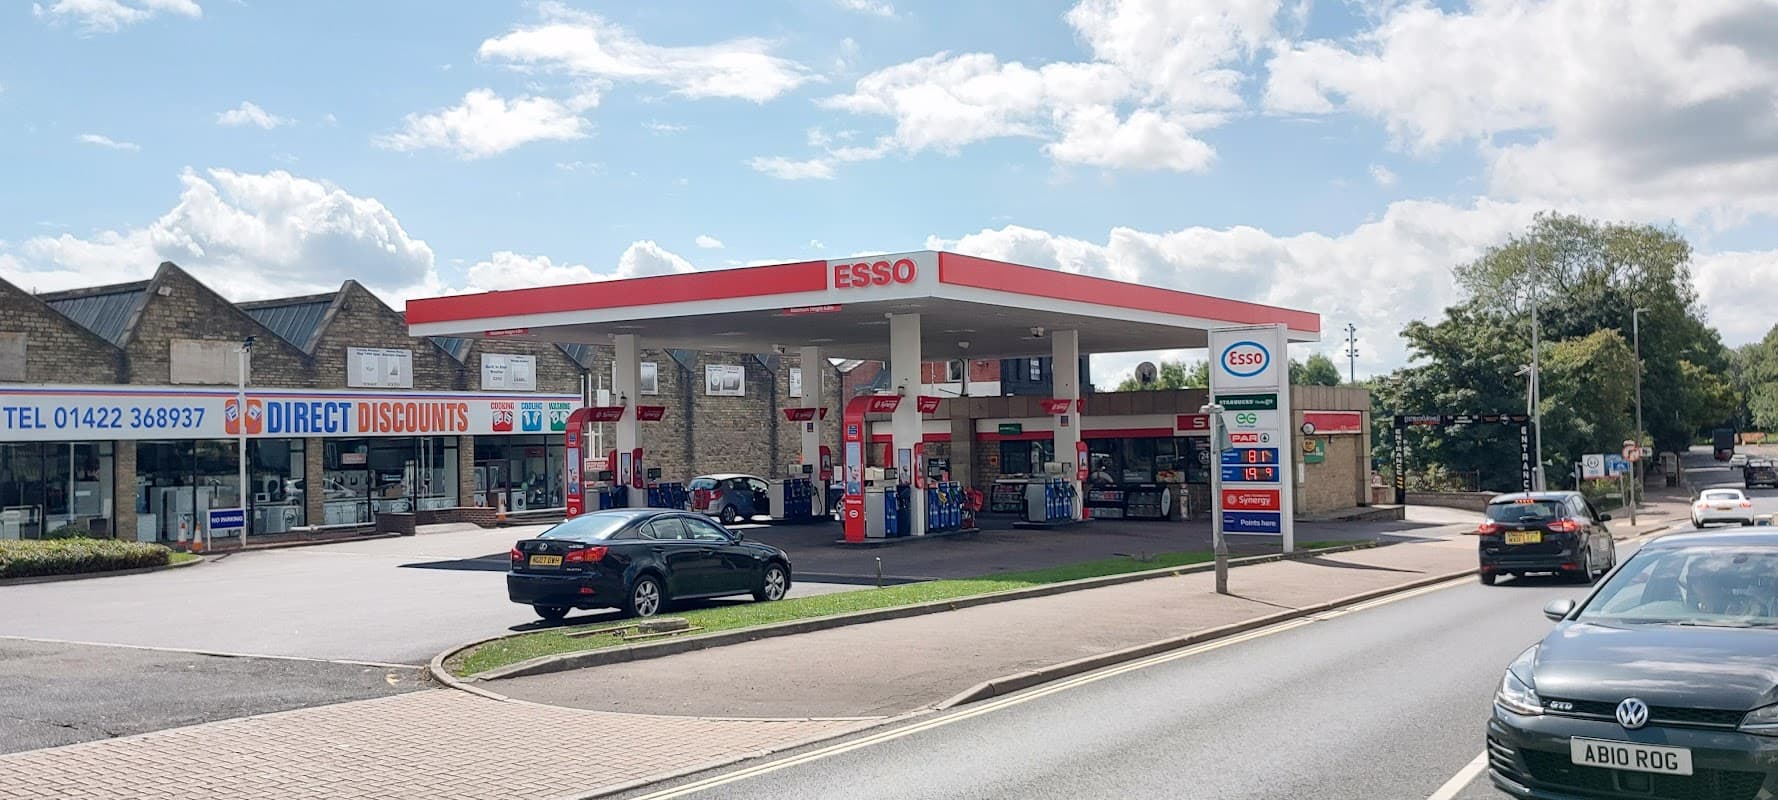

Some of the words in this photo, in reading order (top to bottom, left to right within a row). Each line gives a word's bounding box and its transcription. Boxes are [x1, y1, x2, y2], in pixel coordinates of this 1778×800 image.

[834, 257, 918, 289] ESSO
[3, 406, 47, 429] TEL
[54, 406, 123, 429] 01422
[130, 407, 206, 429] 368937
[267, 401, 351, 433] DIRECT
[358, 401, 469, 433] DISCOUNTS
[1229, 434, 1258, 442] PAR
[1394, 428, 1404, 476] ENTRANCE
[1238, 495, 1271, 507] Synergy
[1240, 519, 1261, 527] Points
[1261, 519, 1277, 527] here
[1635, 748, 1679, 771] ROG
